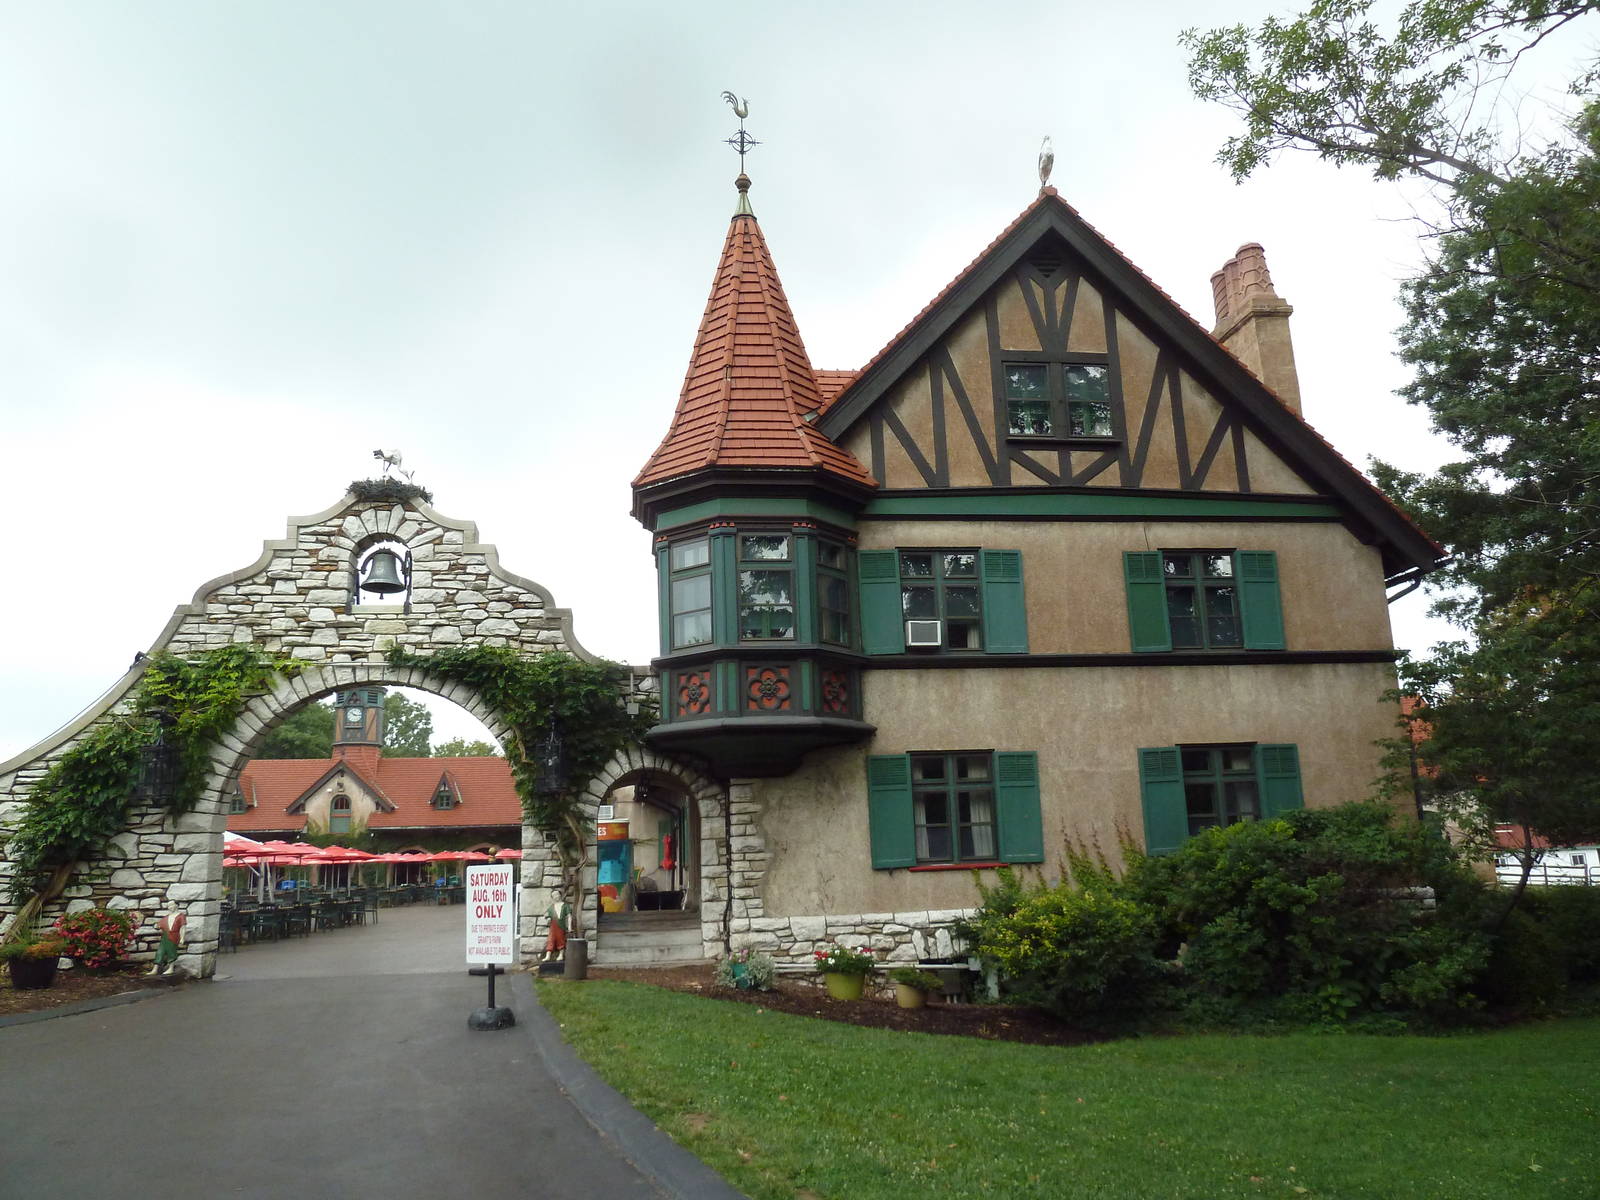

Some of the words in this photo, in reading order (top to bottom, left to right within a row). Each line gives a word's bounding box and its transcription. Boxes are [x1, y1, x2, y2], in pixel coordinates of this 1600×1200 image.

[470, 872, 509, 887] SATURDAY
[472, 889, 490, 903] AUG.
[492, 889, 507, 902] 16th
[475, 905, 503, 919] ONLY
